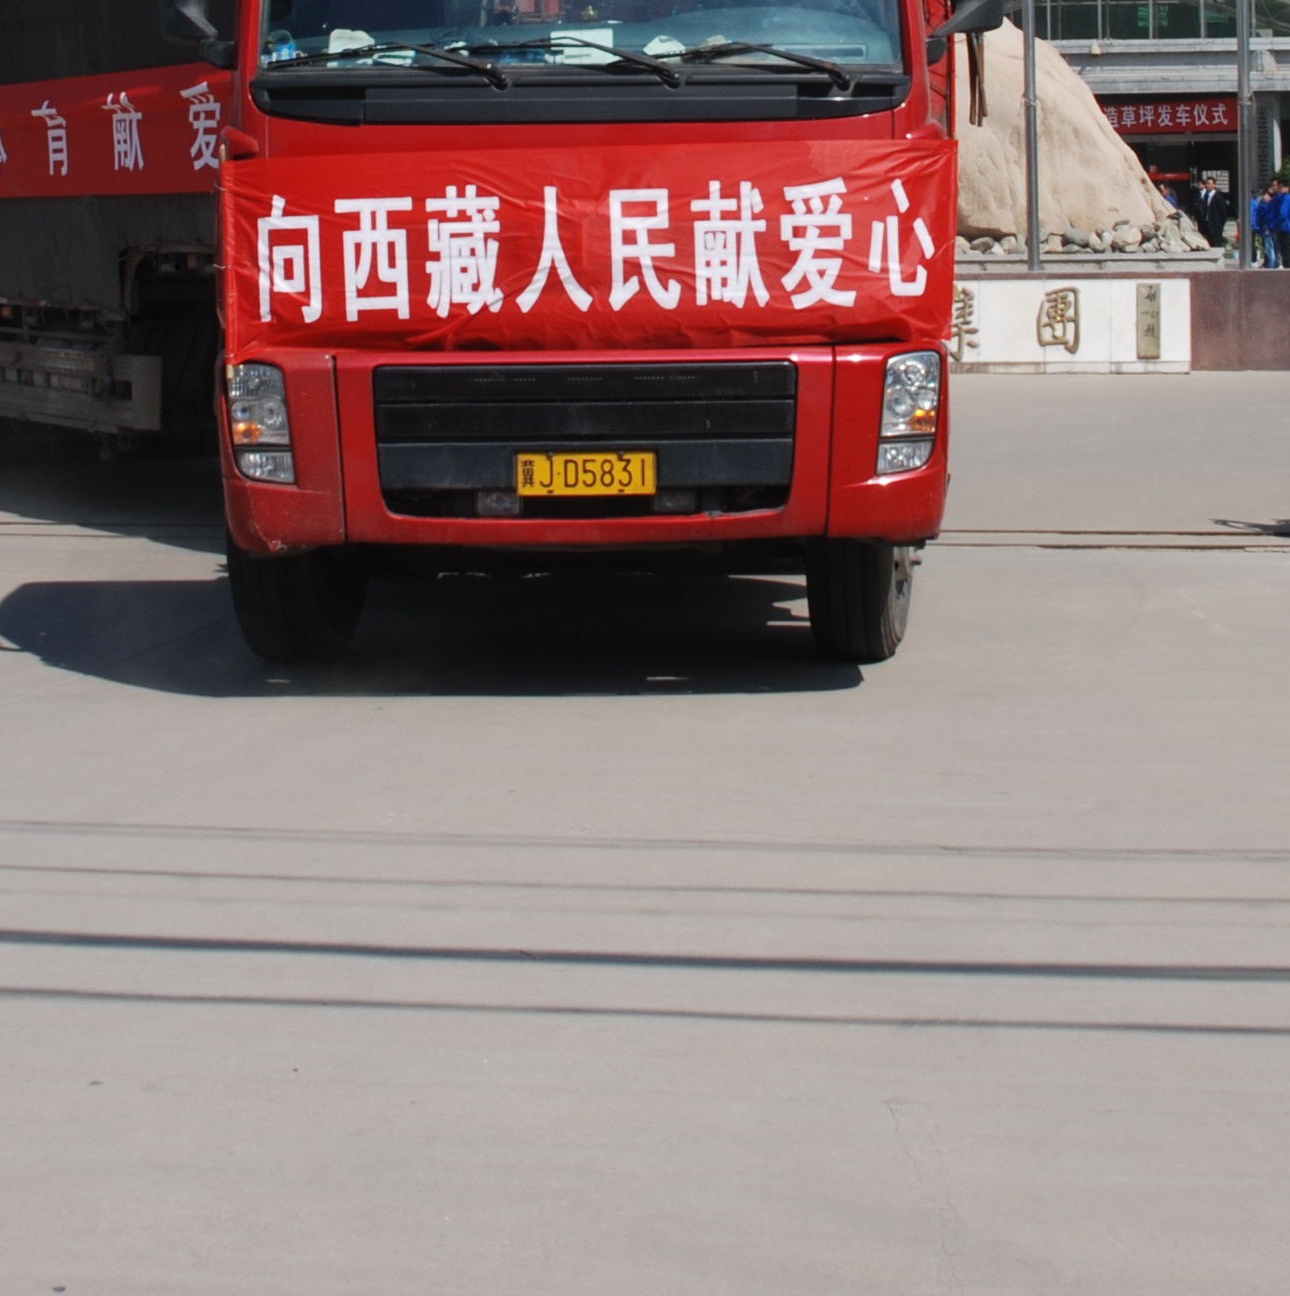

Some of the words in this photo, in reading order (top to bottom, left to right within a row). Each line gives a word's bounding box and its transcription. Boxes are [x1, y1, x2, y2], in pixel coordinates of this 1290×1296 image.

[256, 177, 936, 324] 向西藏人民献爱心
